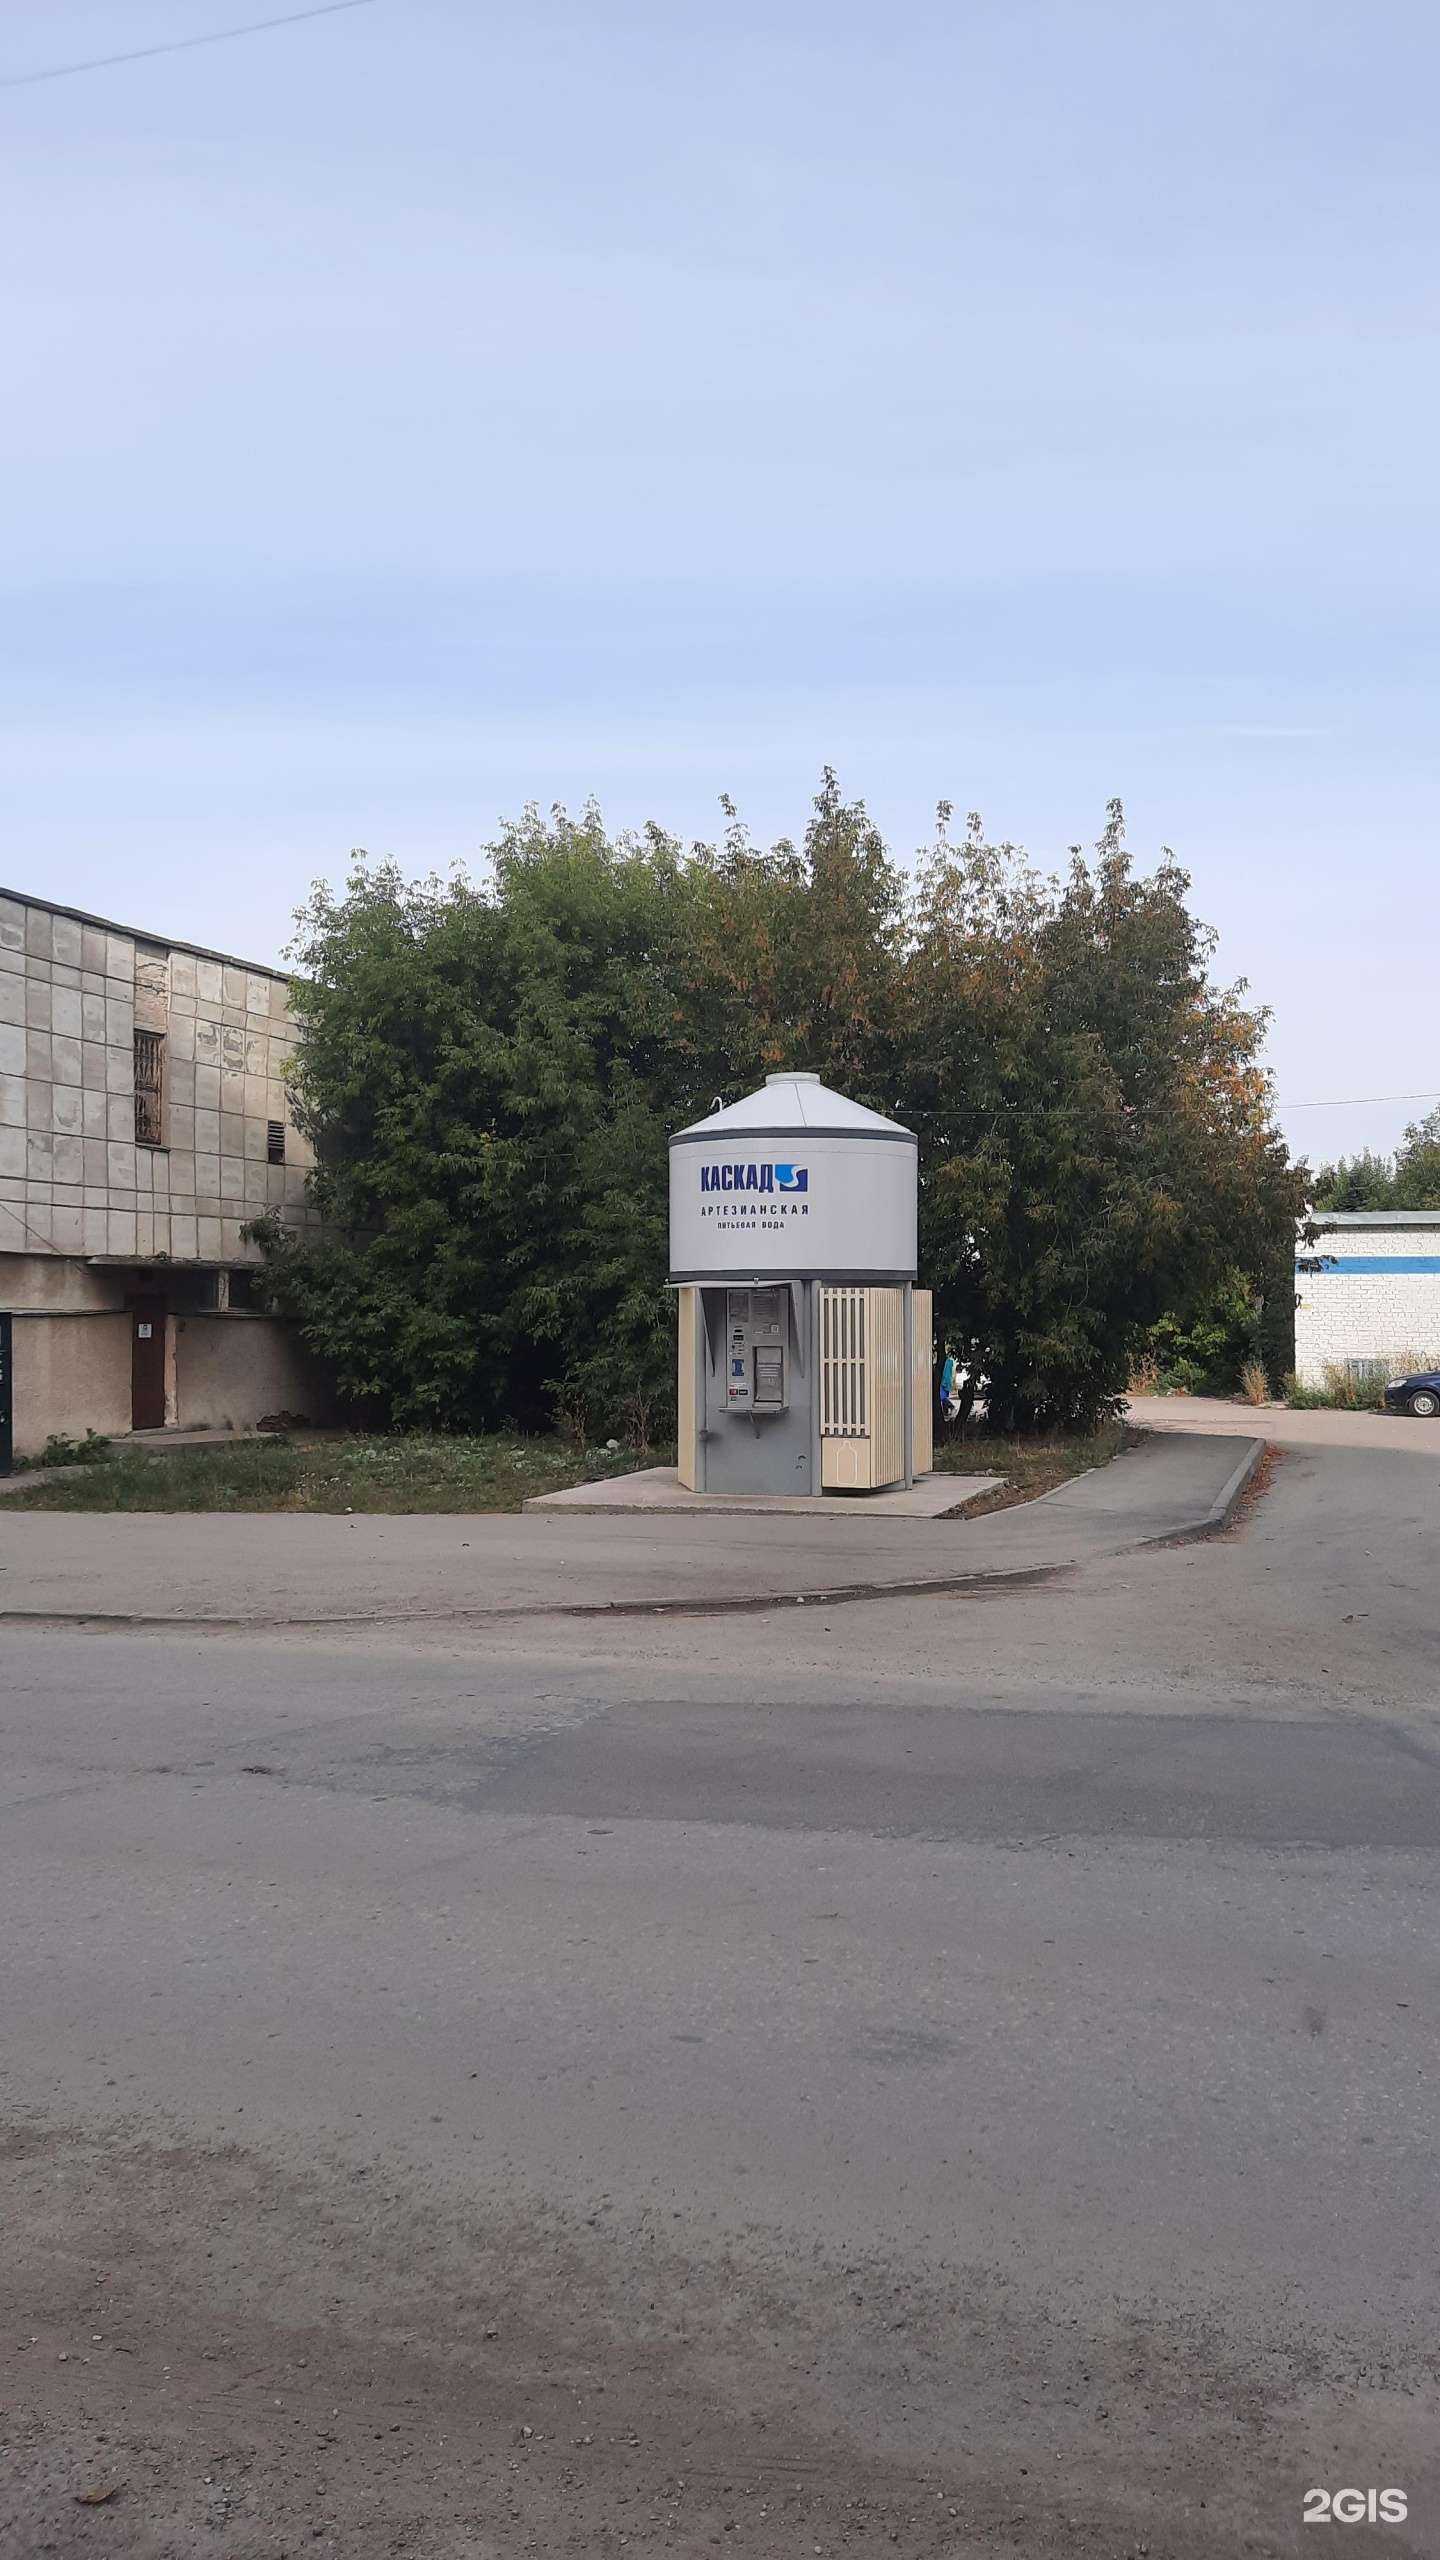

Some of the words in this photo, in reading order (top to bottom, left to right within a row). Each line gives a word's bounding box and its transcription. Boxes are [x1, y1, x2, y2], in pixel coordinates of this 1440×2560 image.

[701, 1164, 774, 1193] КАСКАД
[701, 1204, 809, 1216] АРТЕЗИАНСКАЯ
[717, 1221, 756, 1229] ПИТЬЕВАЯ
[762, 1221, 784, 1229] ВОДА
